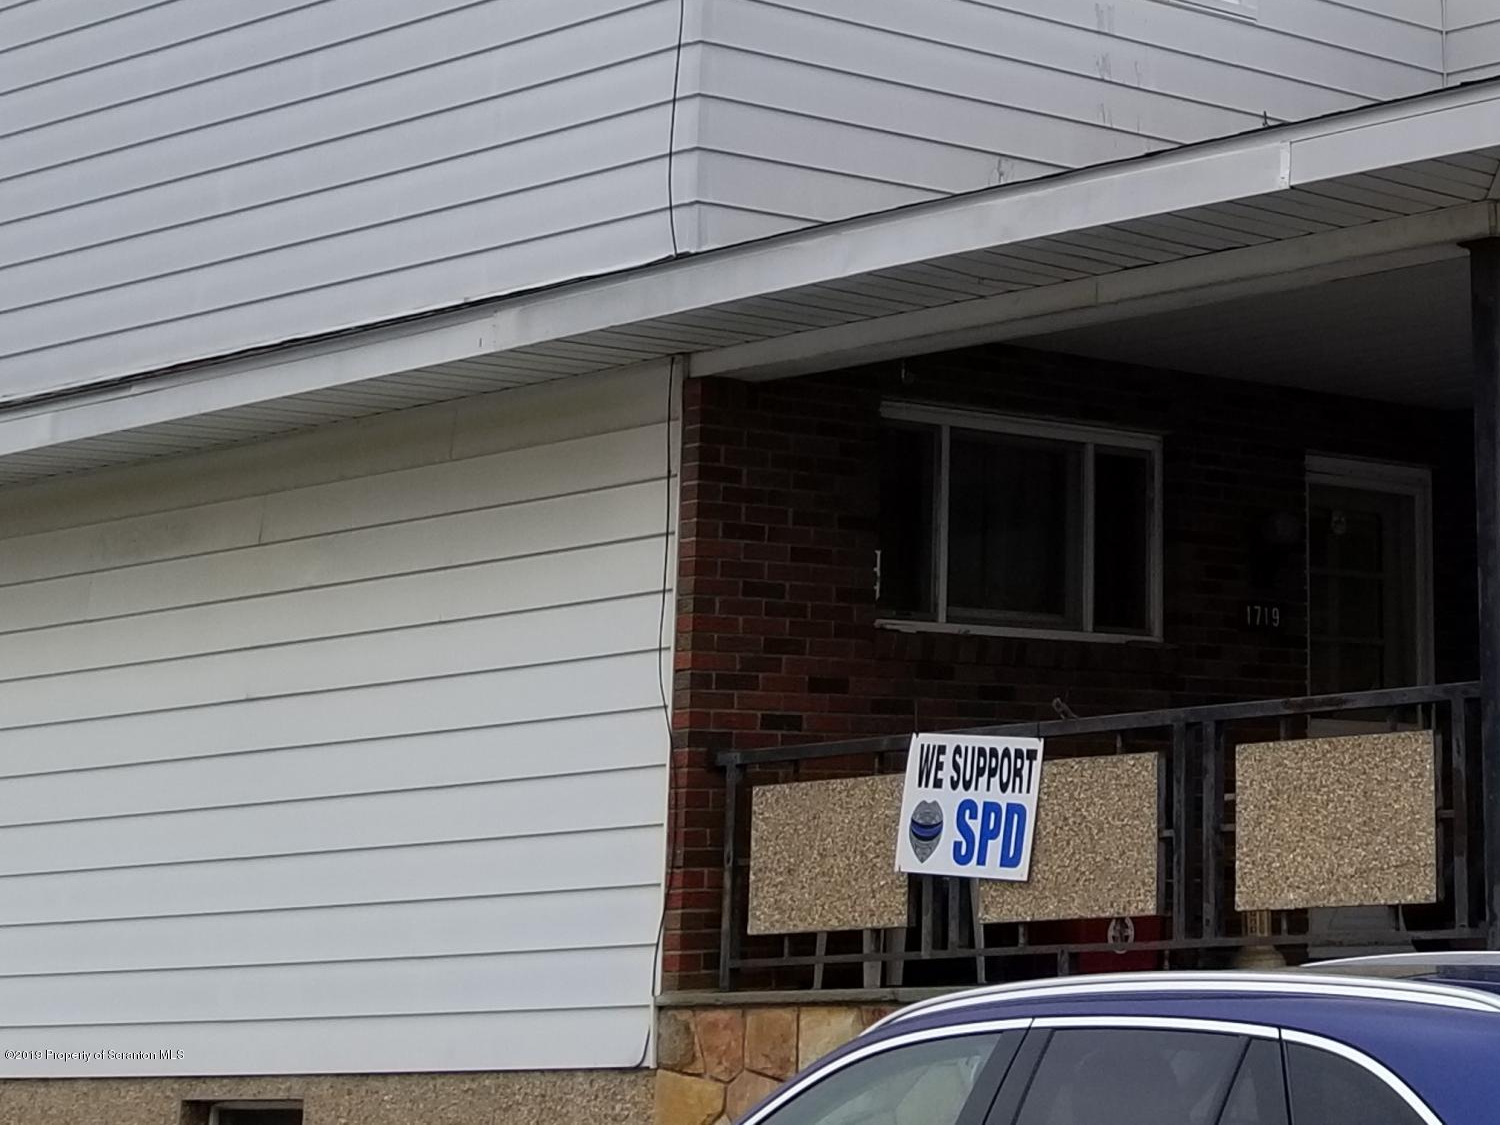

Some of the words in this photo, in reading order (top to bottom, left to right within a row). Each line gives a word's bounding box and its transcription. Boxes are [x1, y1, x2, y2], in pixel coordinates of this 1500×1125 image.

[1247, 605, 1280, 627] 1719
[917, 743, 947, 789] WE
[950, 744, 1038, 794] SUPPORT
[952, 798, 1027, 868] SPD
